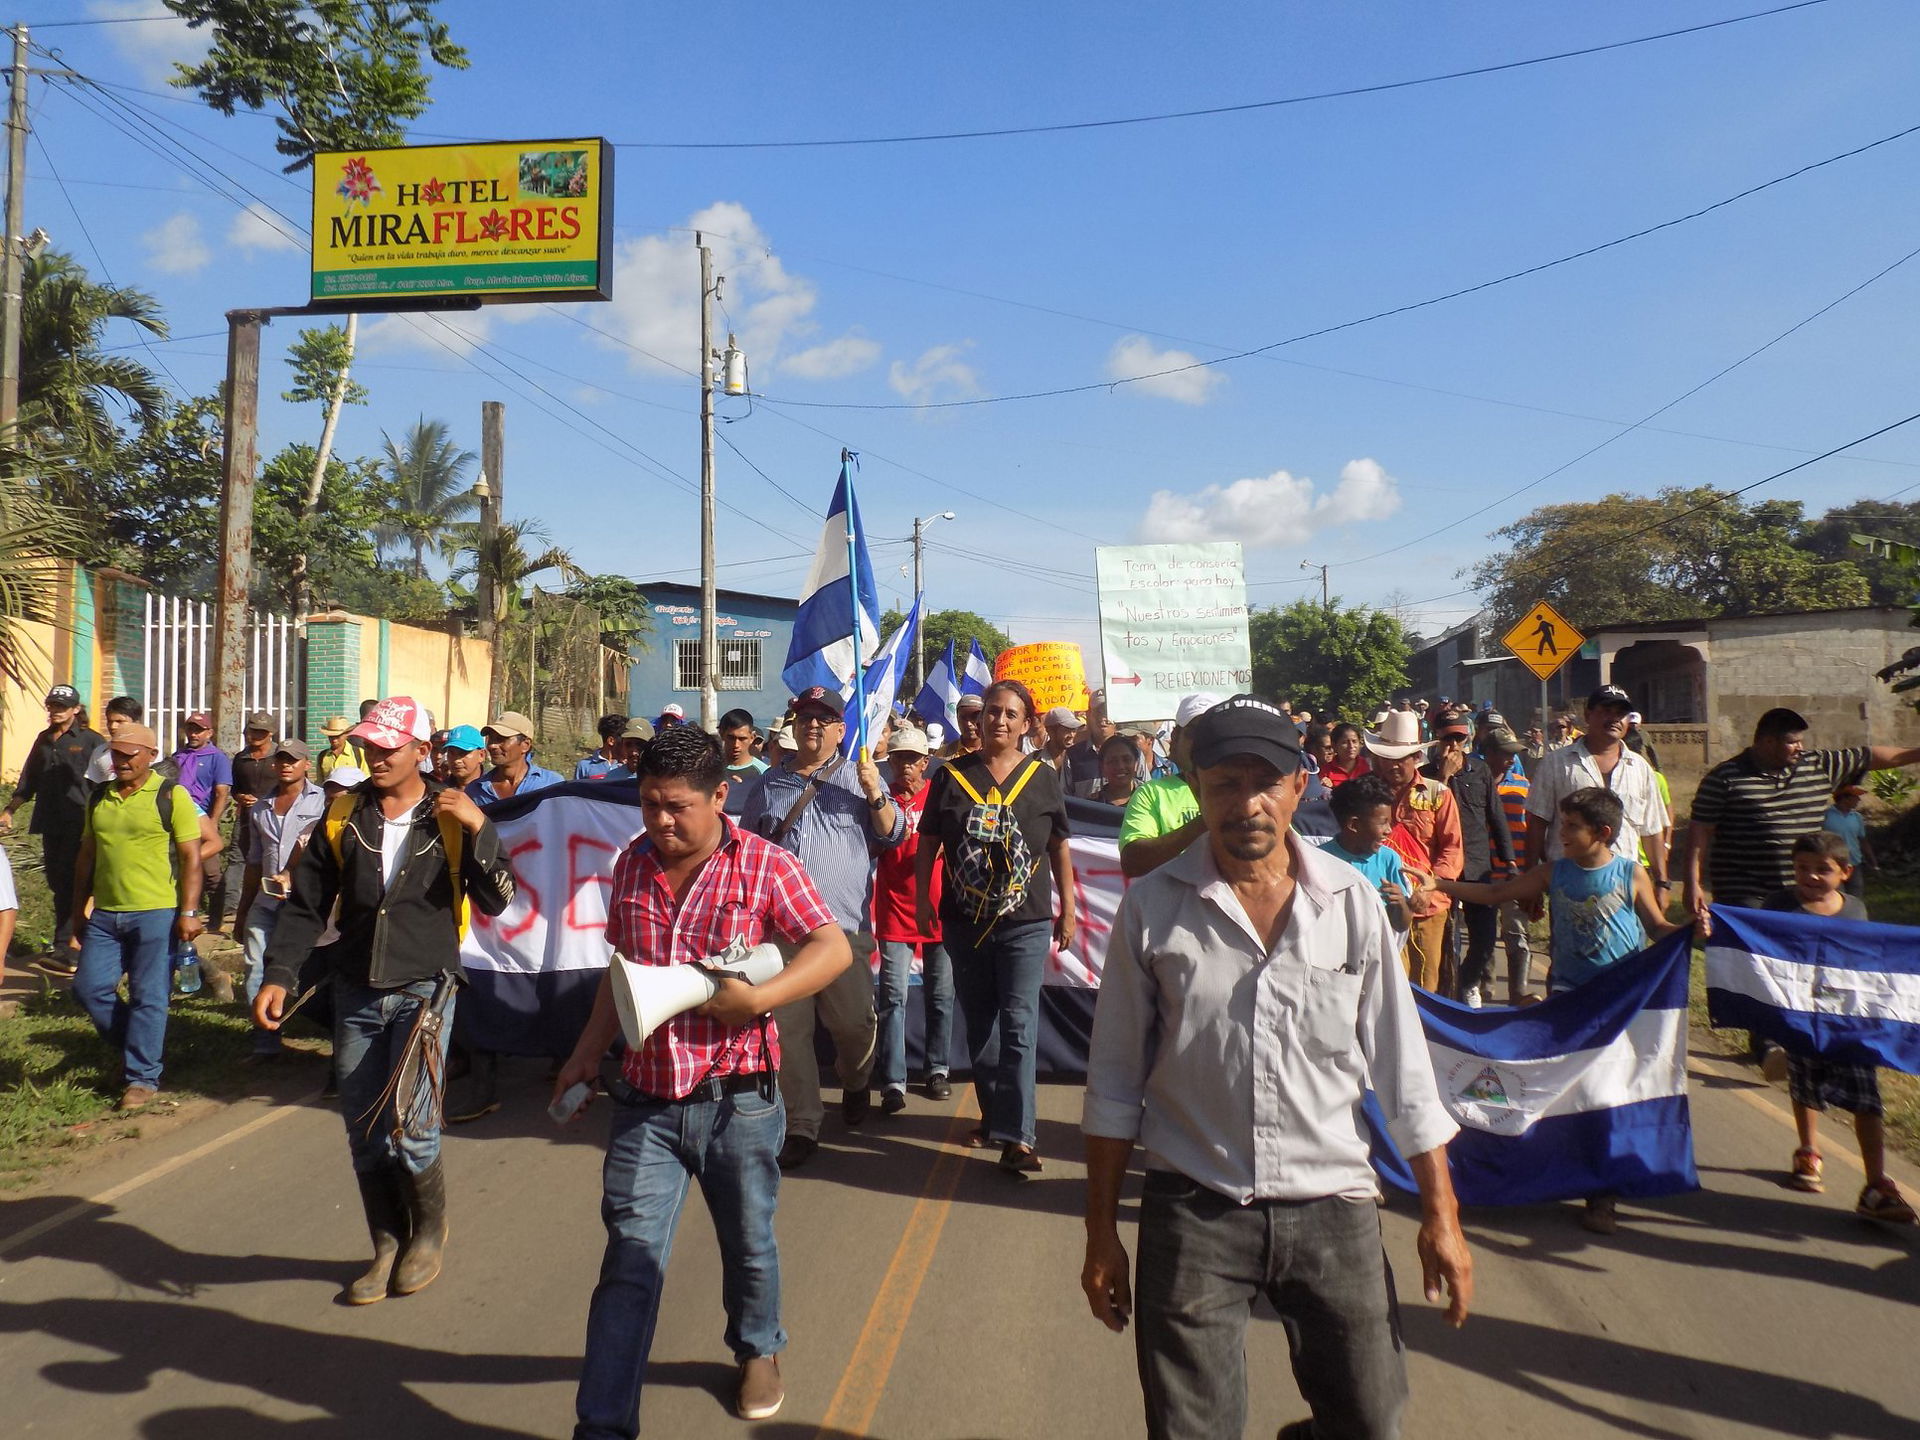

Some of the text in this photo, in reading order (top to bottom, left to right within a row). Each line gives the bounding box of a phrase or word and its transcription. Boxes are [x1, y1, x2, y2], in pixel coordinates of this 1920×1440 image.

[396, 177, 509, 206] HOTEL
[330, 206, 581, 248] MIRAFLORES
[386, 252, 395, 260] la
[397, 250, 414, 259] vida
[416, 249, 446, 260] trabaja
[1122, 559, 1157, 573] Tema
[1168, 554, 1184, 569] de
[1183, 577, 1212, 591] para
[1215, 573, 1235, 590] hoy
[1124, 631, 1149, 648] tos
[1157, 637, 1164, 652] y
[1034, 665, 1050, 673] DE
[1053, 662, 1072, 671] MIS
[1153, 668, 1253, 689] REFLEXIONEMOS
[1061, 684, 1073, 692] DE
[1234, 699, 1281, 717] VIENE
